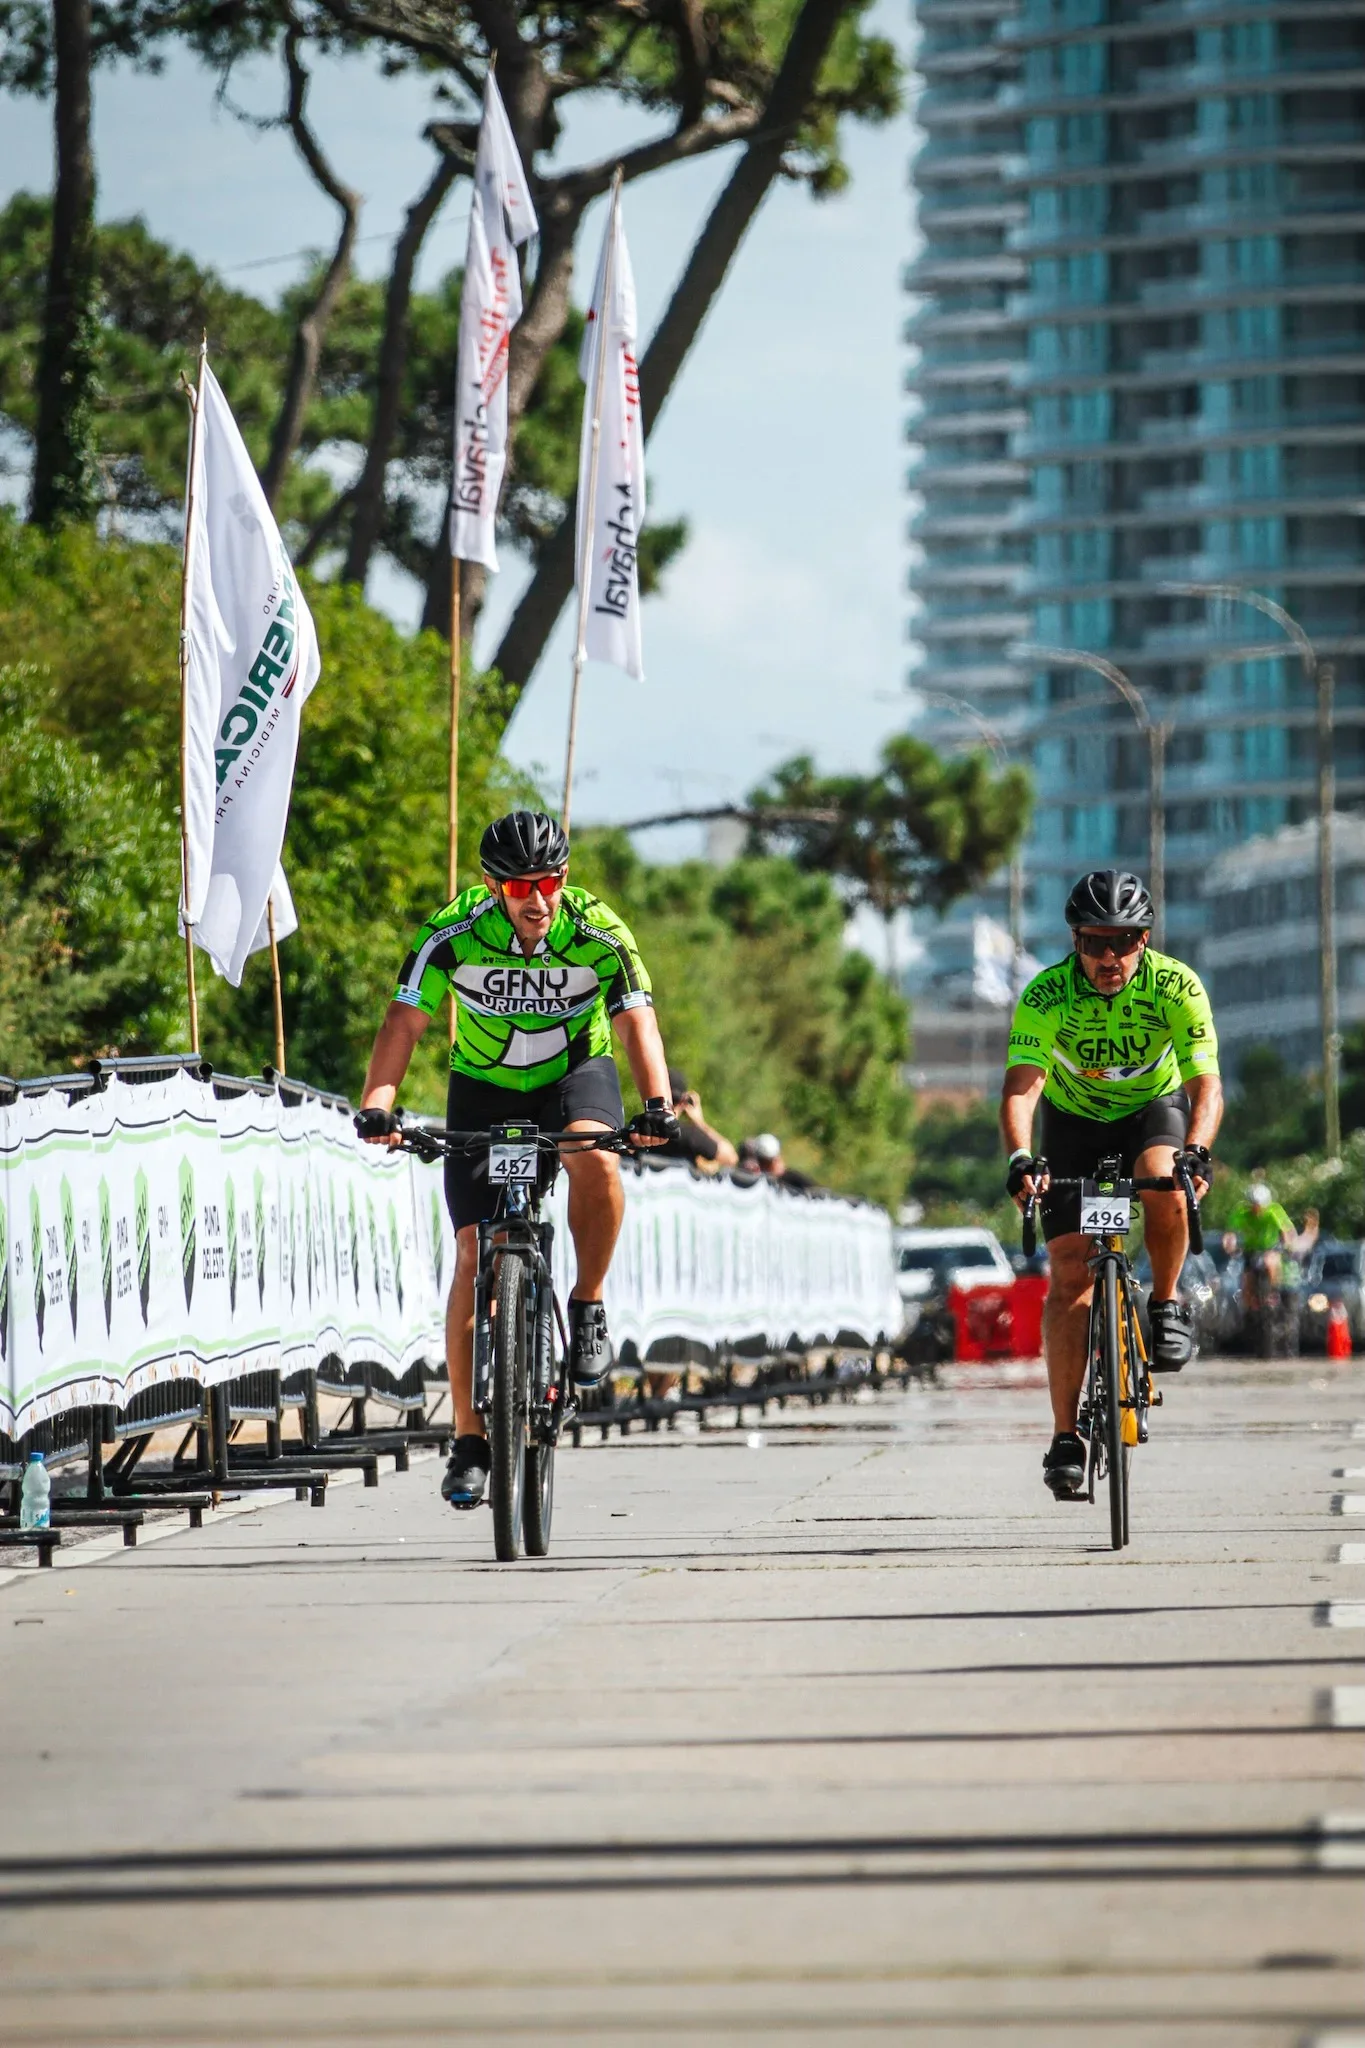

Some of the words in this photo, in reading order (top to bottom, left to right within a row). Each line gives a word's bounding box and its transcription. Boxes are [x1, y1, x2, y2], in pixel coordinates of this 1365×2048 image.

[483, 968, 568, 998] GFNY
[1023, 974, 1067, 1009] GFNY
[481, 995, 571, 1014] URUGUAY
[1009, 1034, 1042, 1048] ALUS
[1076, 1033, 1151, 1061] GFNY
[1081, 1058, 1147, 1069] URUGUAY
[1087, 1211, 1124, 1227] 496
